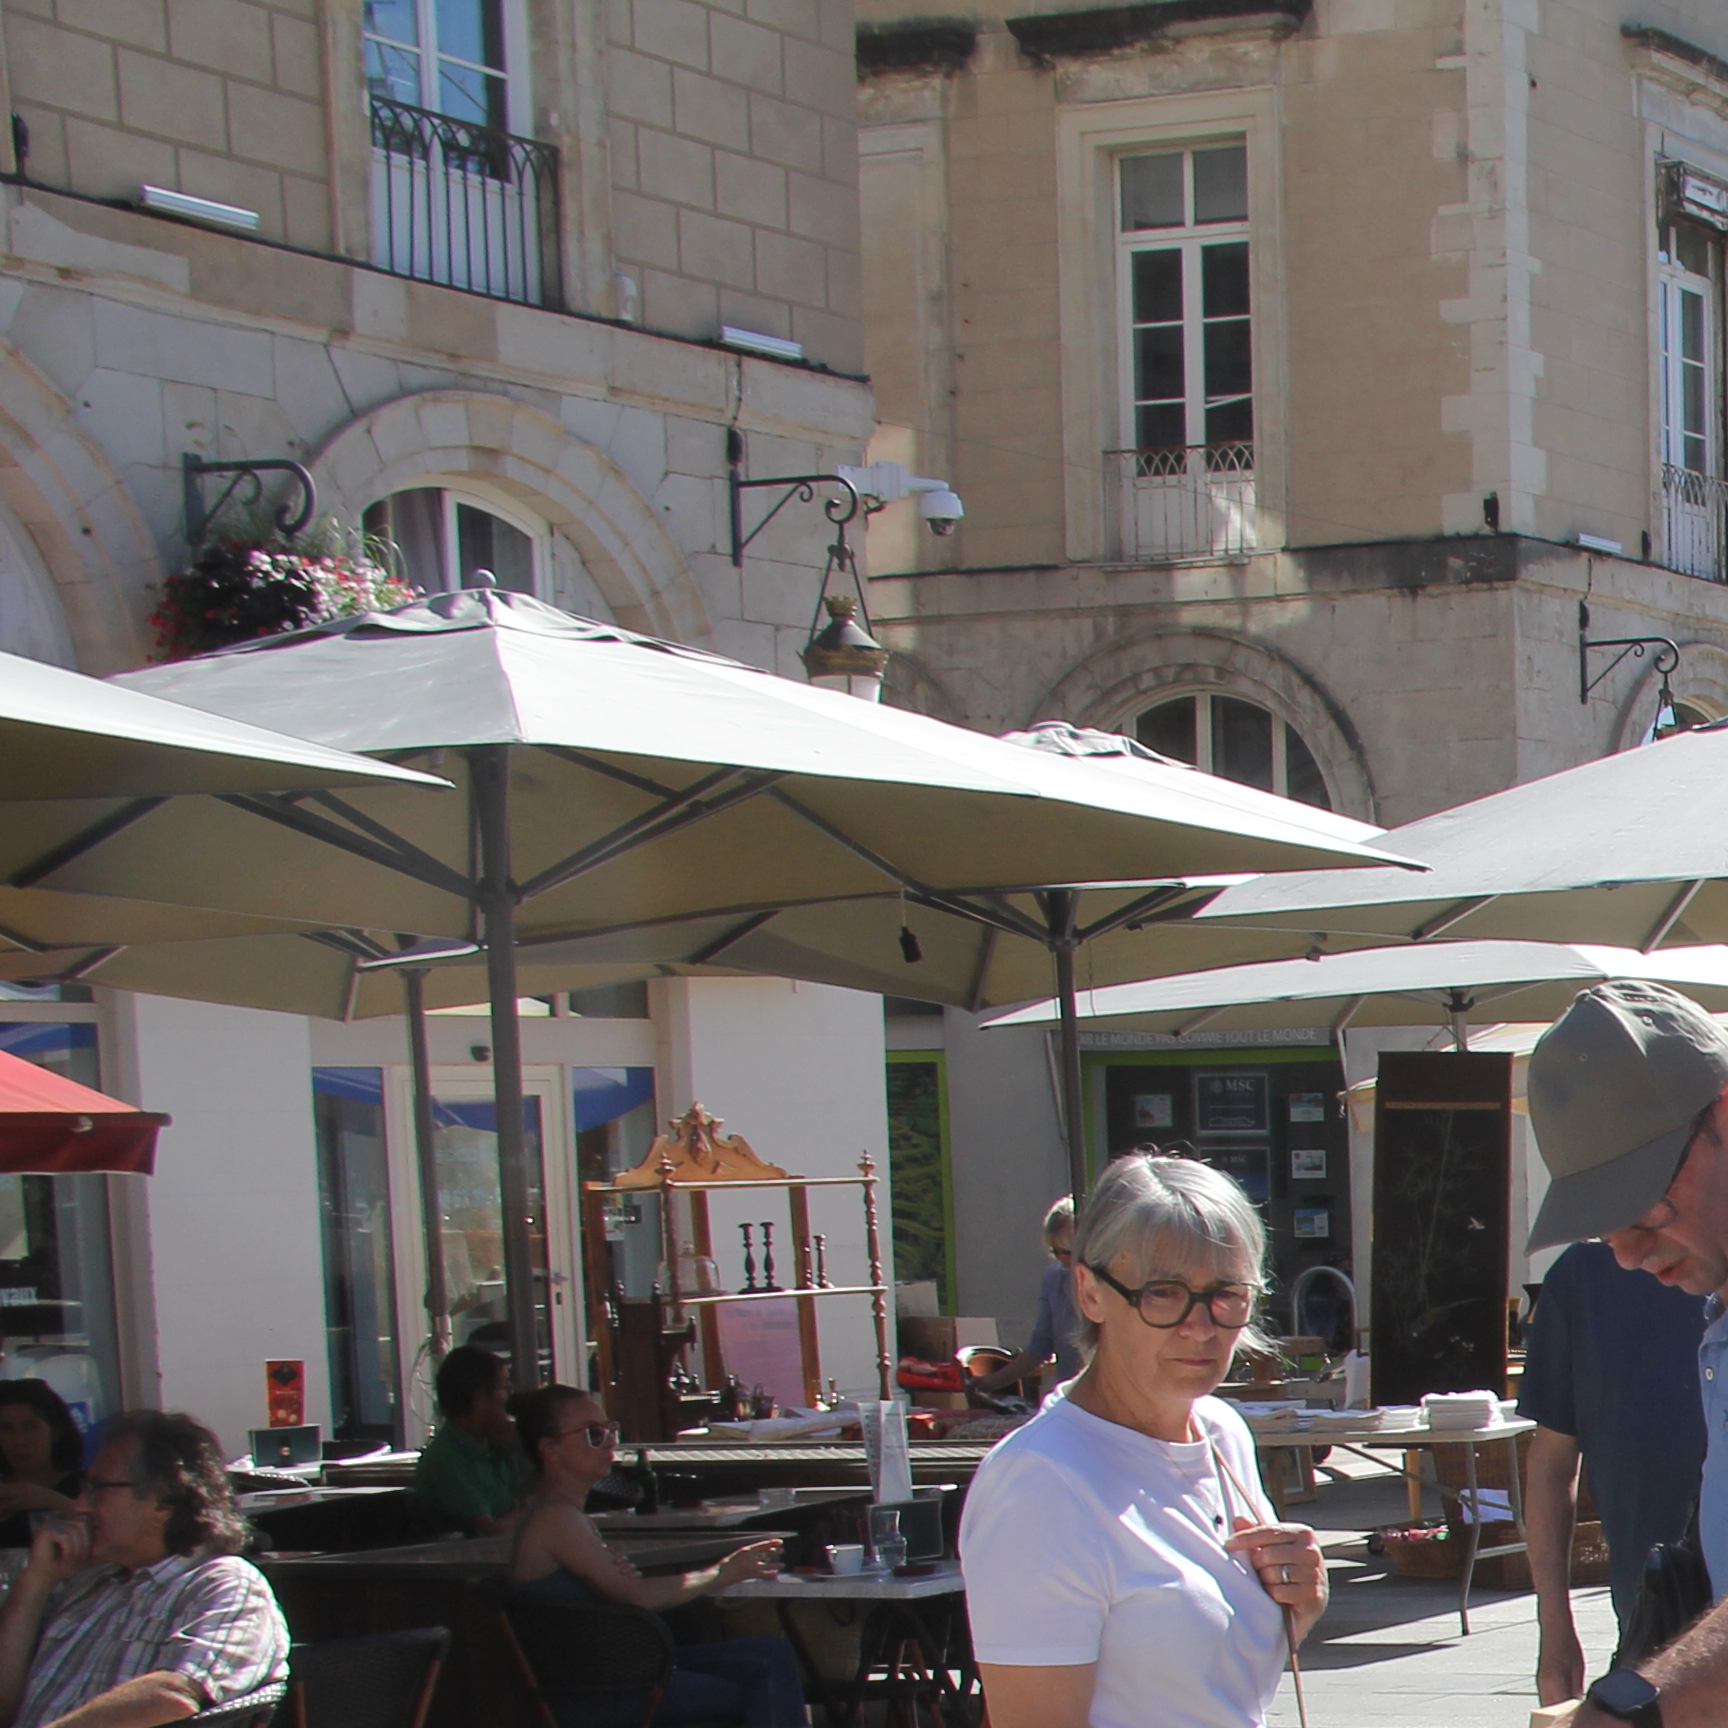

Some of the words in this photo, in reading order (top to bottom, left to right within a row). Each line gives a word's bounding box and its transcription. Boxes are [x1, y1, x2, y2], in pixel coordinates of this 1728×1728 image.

[1110, 1033, 1155, 1046] MONDE
[1225, 1030, 1252, 1044] TOUT
[1258, 1030, 1272, 1042] LE
[1273, 1028, 1316, 1042] MONDE
[1225, 1078, 1256, 1092] MSC
